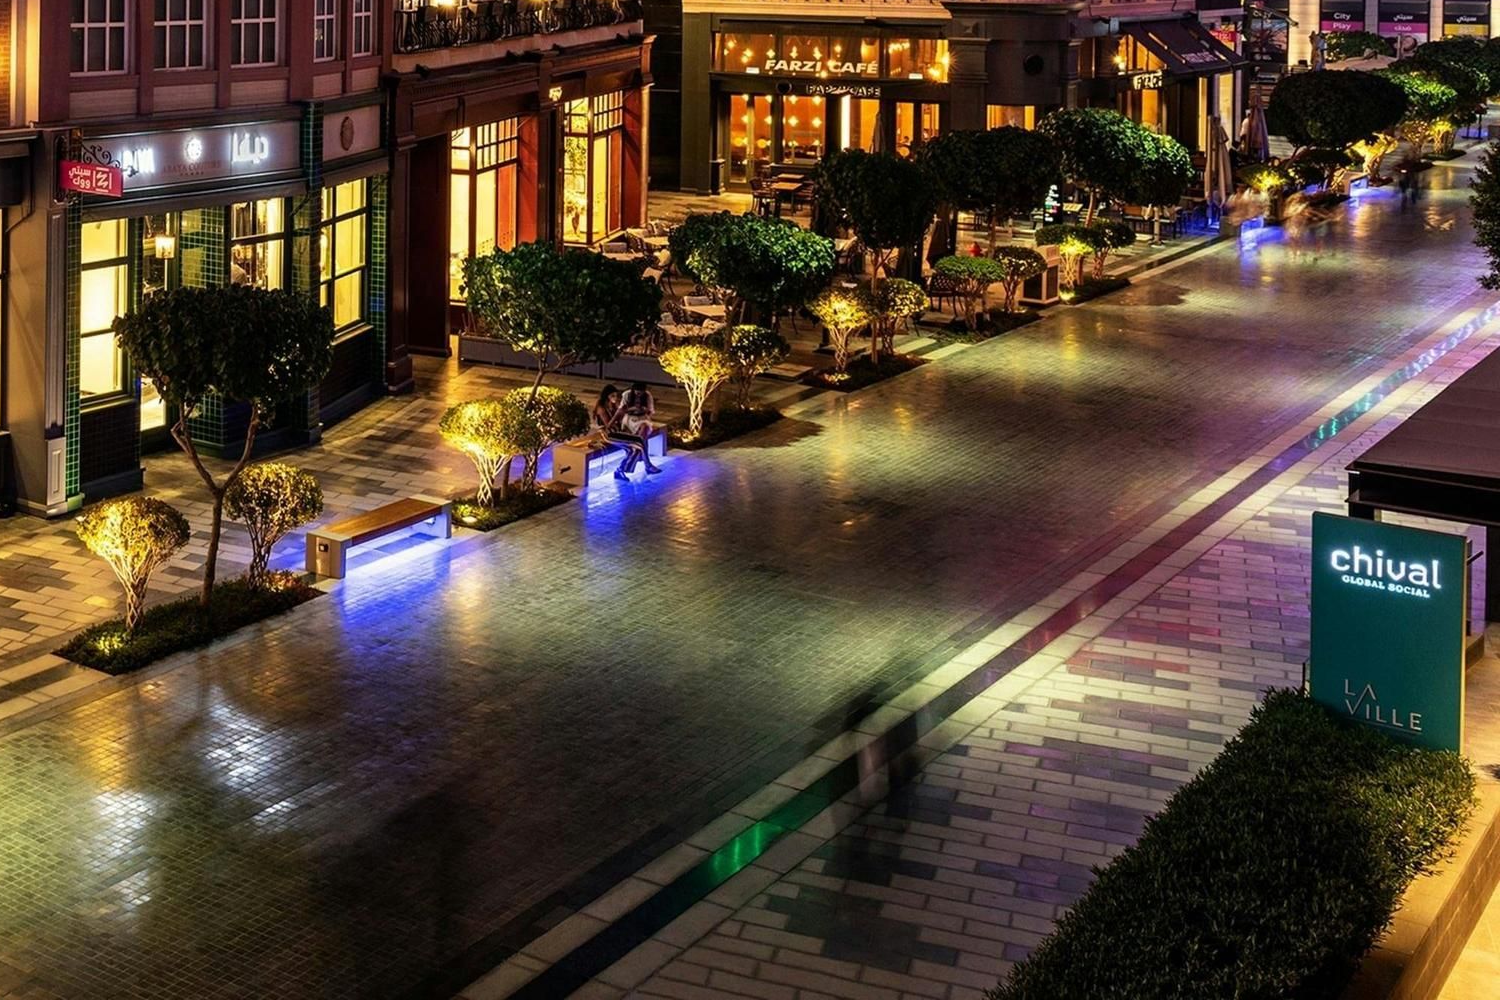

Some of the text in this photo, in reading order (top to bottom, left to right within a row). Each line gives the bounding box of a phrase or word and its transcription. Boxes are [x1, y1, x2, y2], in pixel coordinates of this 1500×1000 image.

[1333, 12, 1351, 21] City
[1332, 22, 1352, 31] Play
[764, 60, 822, 73] FARZI
[68, 165, 92, 179] سيتي
[1330, 545, 1442, 589] chival
[1341, 574, 1431, 599] GLOBAL SOCIAL
[1344, 678, 1377, 701] LA
[1344, 698, 1423, 732] VILLE
